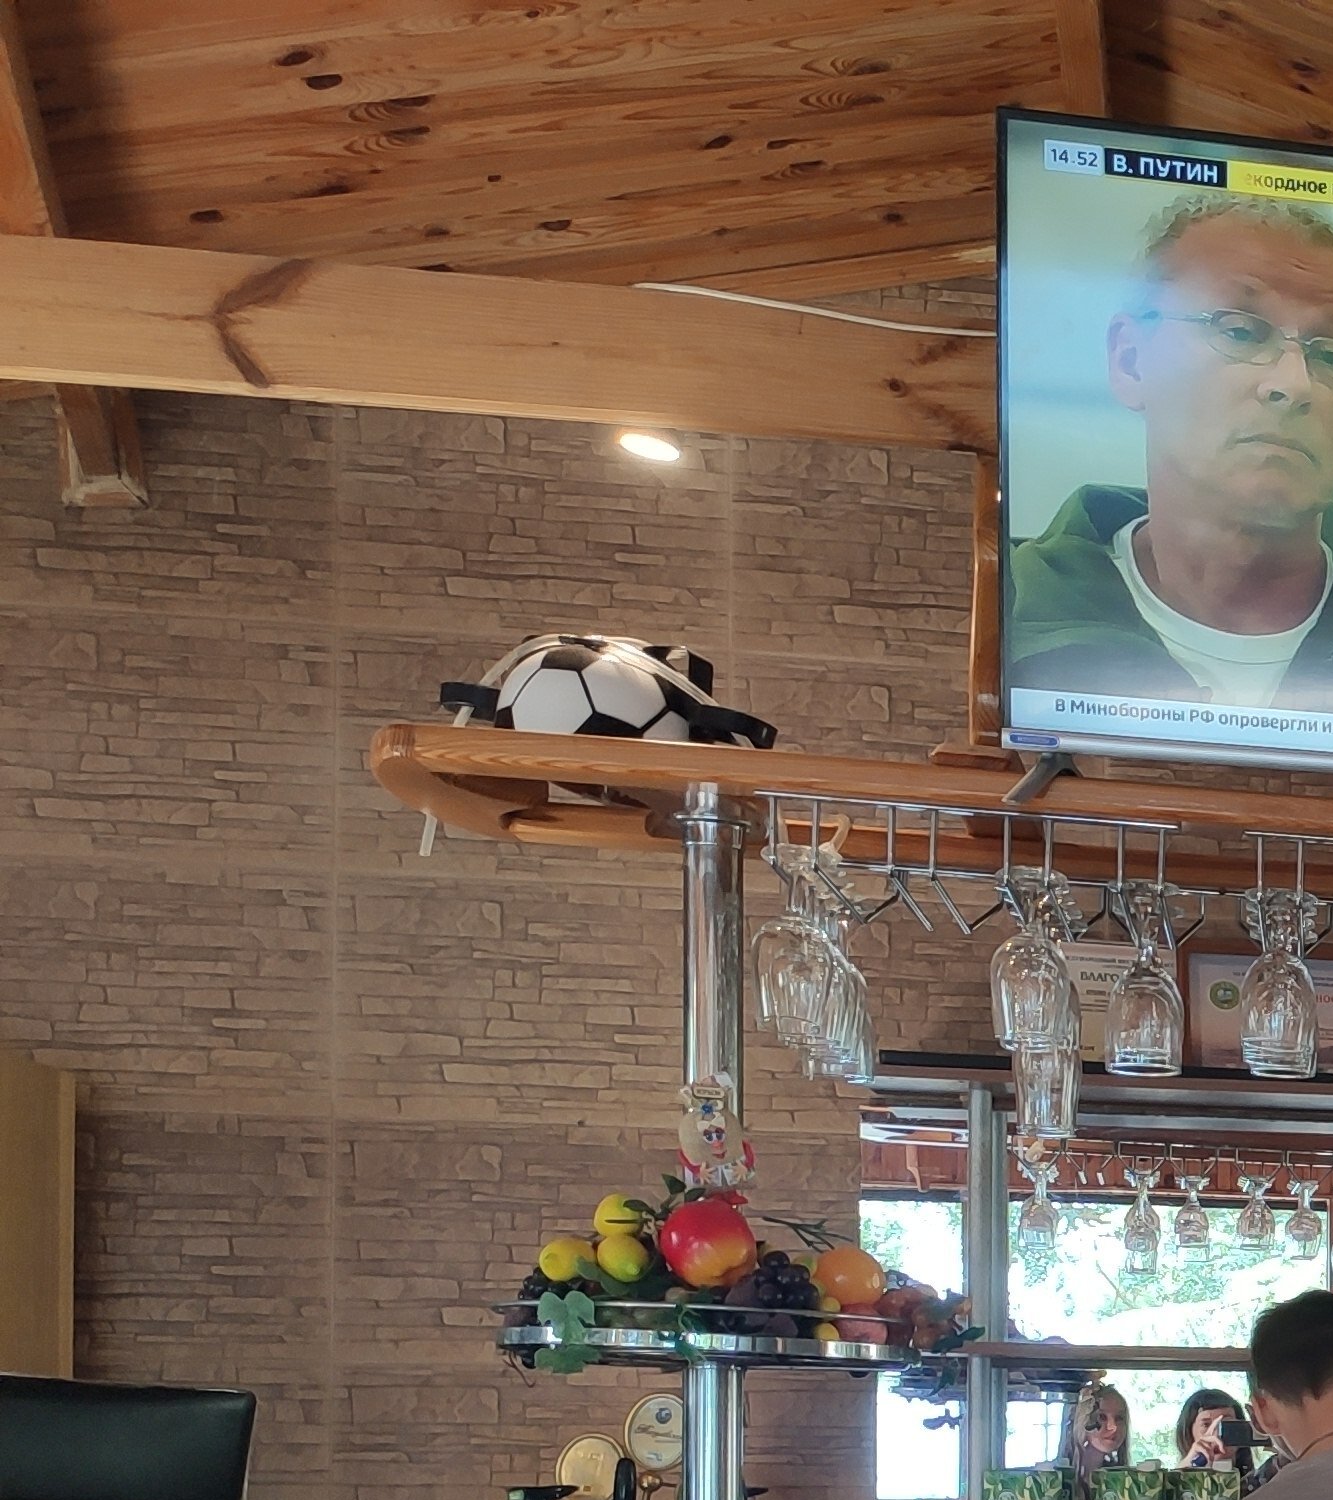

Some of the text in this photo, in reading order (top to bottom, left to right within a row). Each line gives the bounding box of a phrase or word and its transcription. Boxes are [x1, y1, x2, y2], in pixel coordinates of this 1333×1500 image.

[1113, 154, 1218, 184] В. ПУТИН
[1055, 698, 1066, 712] В
[1070, 700, 1185, 721] Минобороны
[1190, 709, 1214, 724] РФ
[1218, 713, 1318, 733] опровергли
[1080, 971, 1119, 983] БЛАГО
